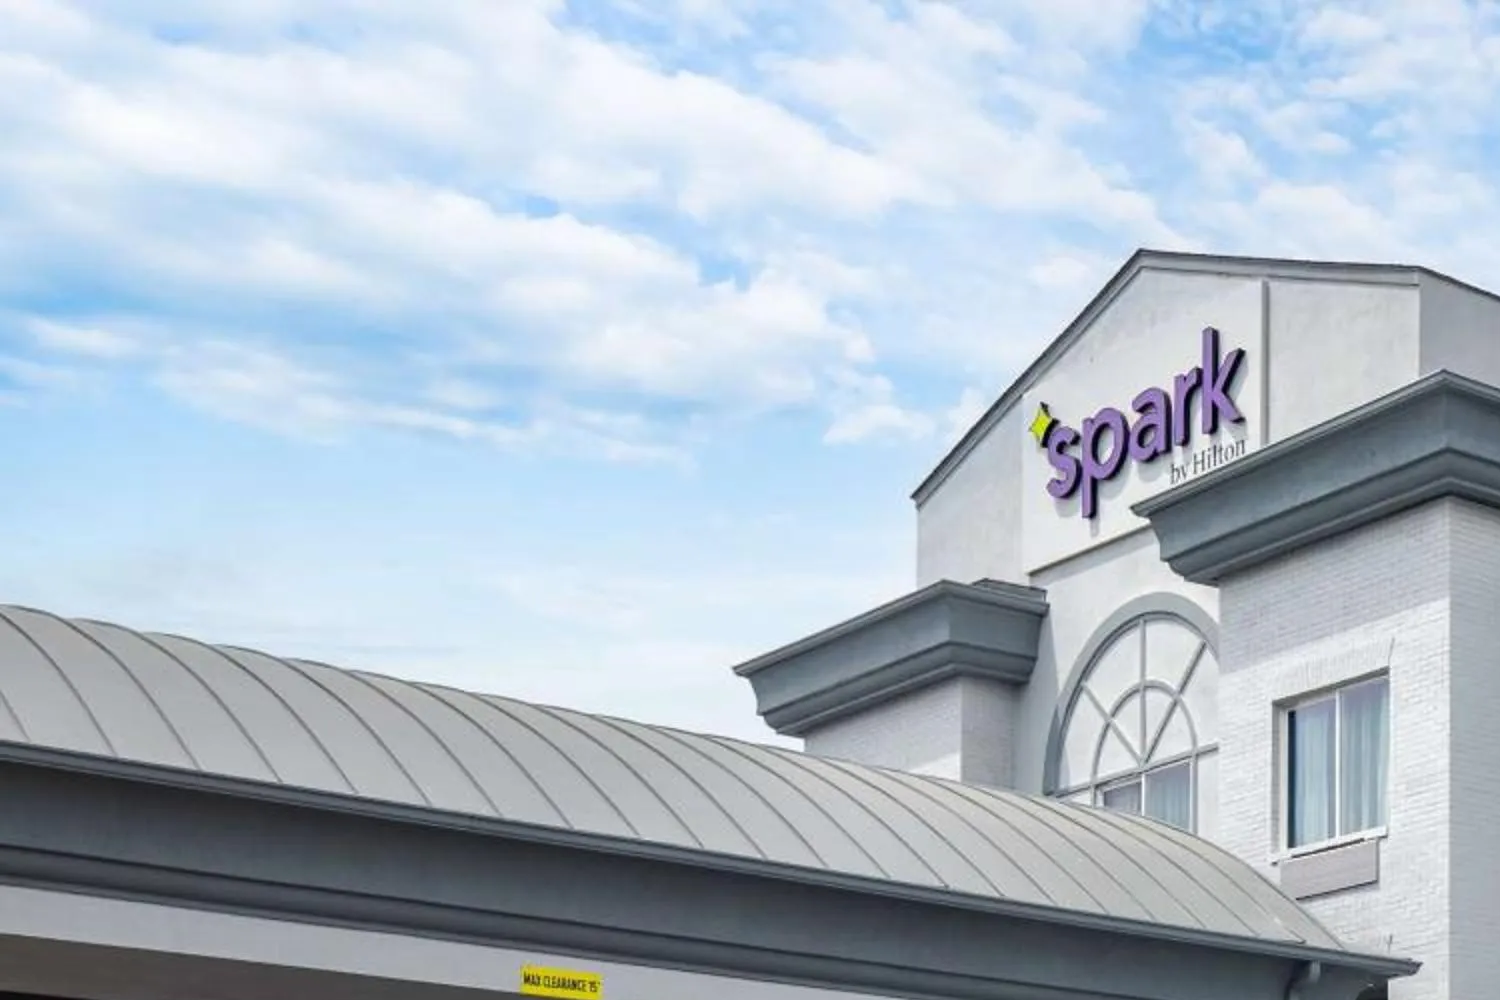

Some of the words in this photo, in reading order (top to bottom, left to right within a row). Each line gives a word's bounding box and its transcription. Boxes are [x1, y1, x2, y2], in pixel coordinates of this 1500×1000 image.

[1046, 326, 1246, 519] spark
[1192, 439, 1246, 475] Hilton
[523, 971, 541, 987] MAX
[543, 975, 588, 993] CLEARANCE
